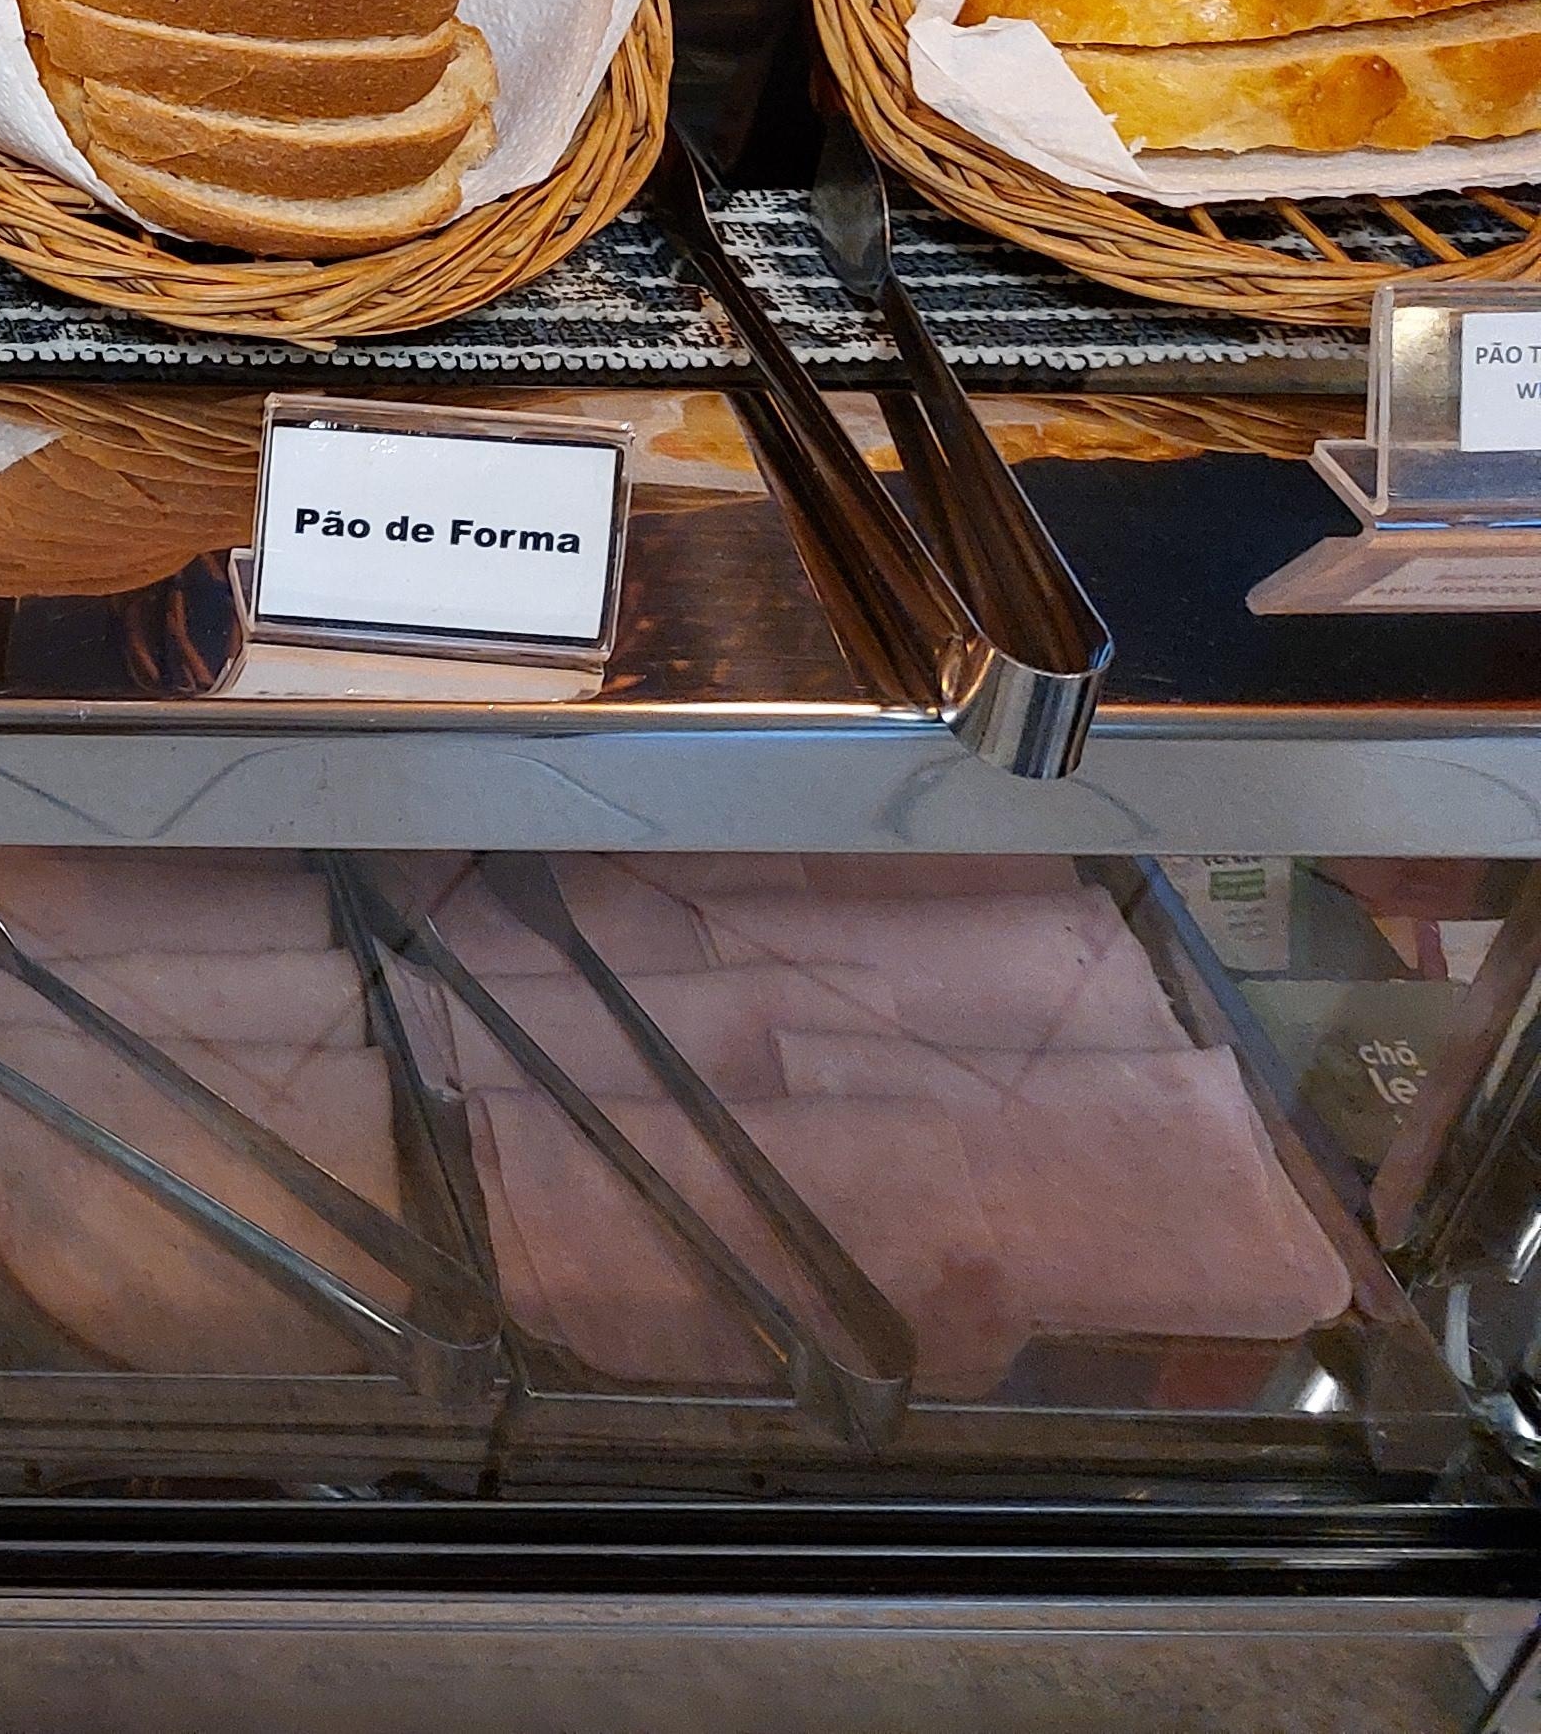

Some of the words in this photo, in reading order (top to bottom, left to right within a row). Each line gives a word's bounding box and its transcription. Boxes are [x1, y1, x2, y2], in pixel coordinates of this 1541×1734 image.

[1476, 341, 1522, 364] PÃO
[294, 508, 371, 540] Pão
[385, 516, 435, 543] de
[450, 519, 580, 555] Forma
